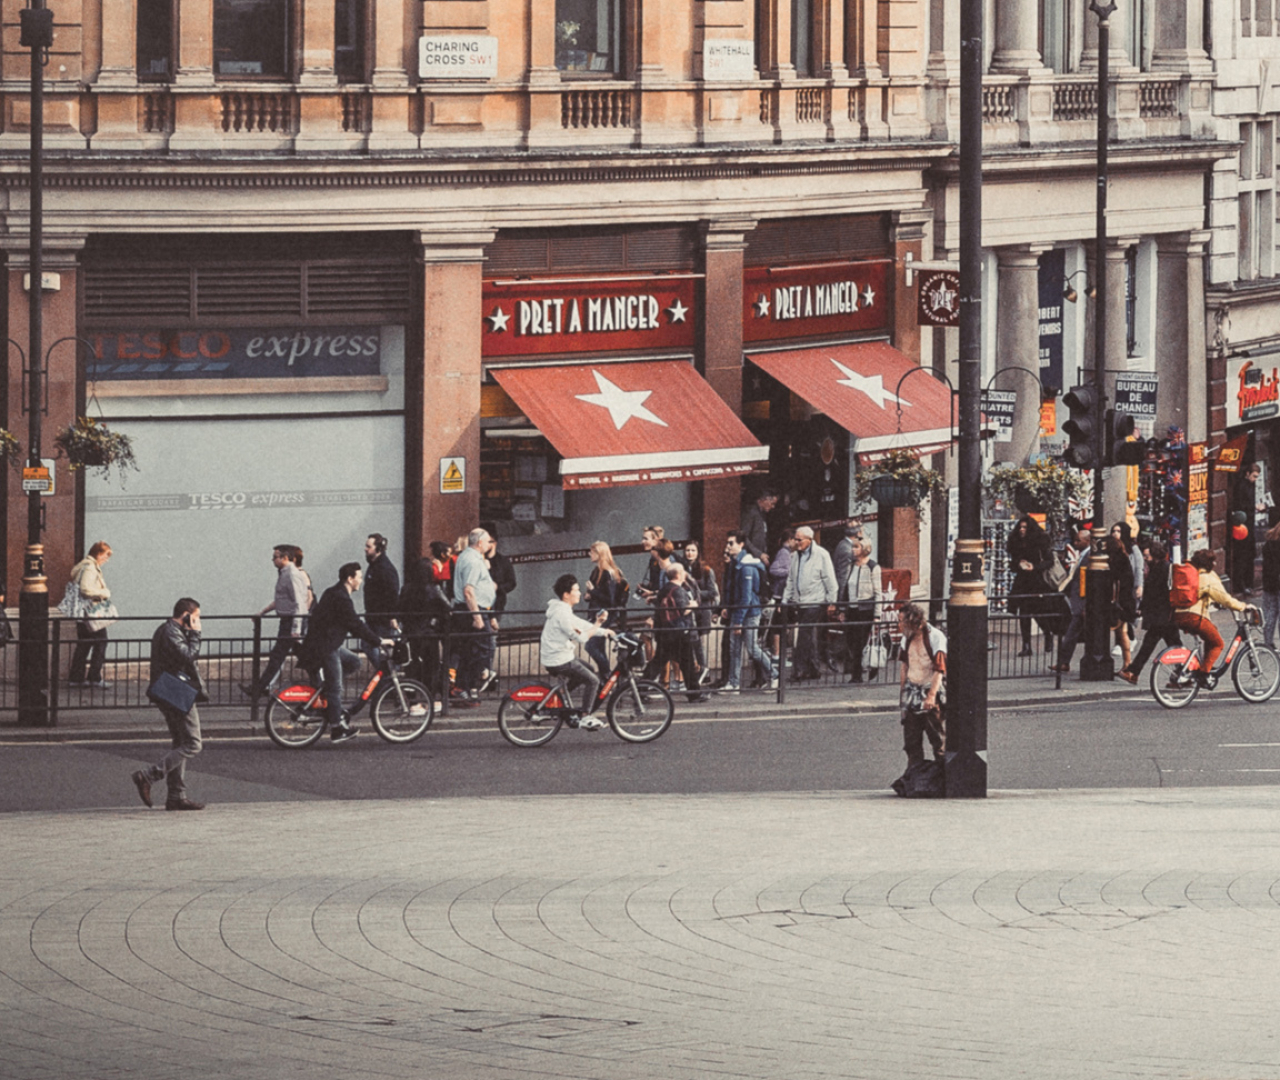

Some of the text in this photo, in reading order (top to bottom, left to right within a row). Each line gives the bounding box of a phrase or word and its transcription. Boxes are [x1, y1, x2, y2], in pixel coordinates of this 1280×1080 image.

[425, 41, 479, 52] CHARING
[709, 45, 750, 56] WHITEHALL
[425, 54, 492, 65] CROSS SW1
[776, 281, 859, 320] PRET A MANGER
[520, 295, 660, 335] PRET A MANGER
[88, 331, 379, 366] TESCO express
[1117, 381, 1156, 392] BUREAU
[1129, 392, 1142, 402] DE
[1115, 402, 1155, 413] CHANGE
[1189, 472, 1208, 492] BUY
[188, 492, 246, 505] TESCO
[251, 492, 305, 507] express
[520, 553, 556, 562] CAPPUCCINO
